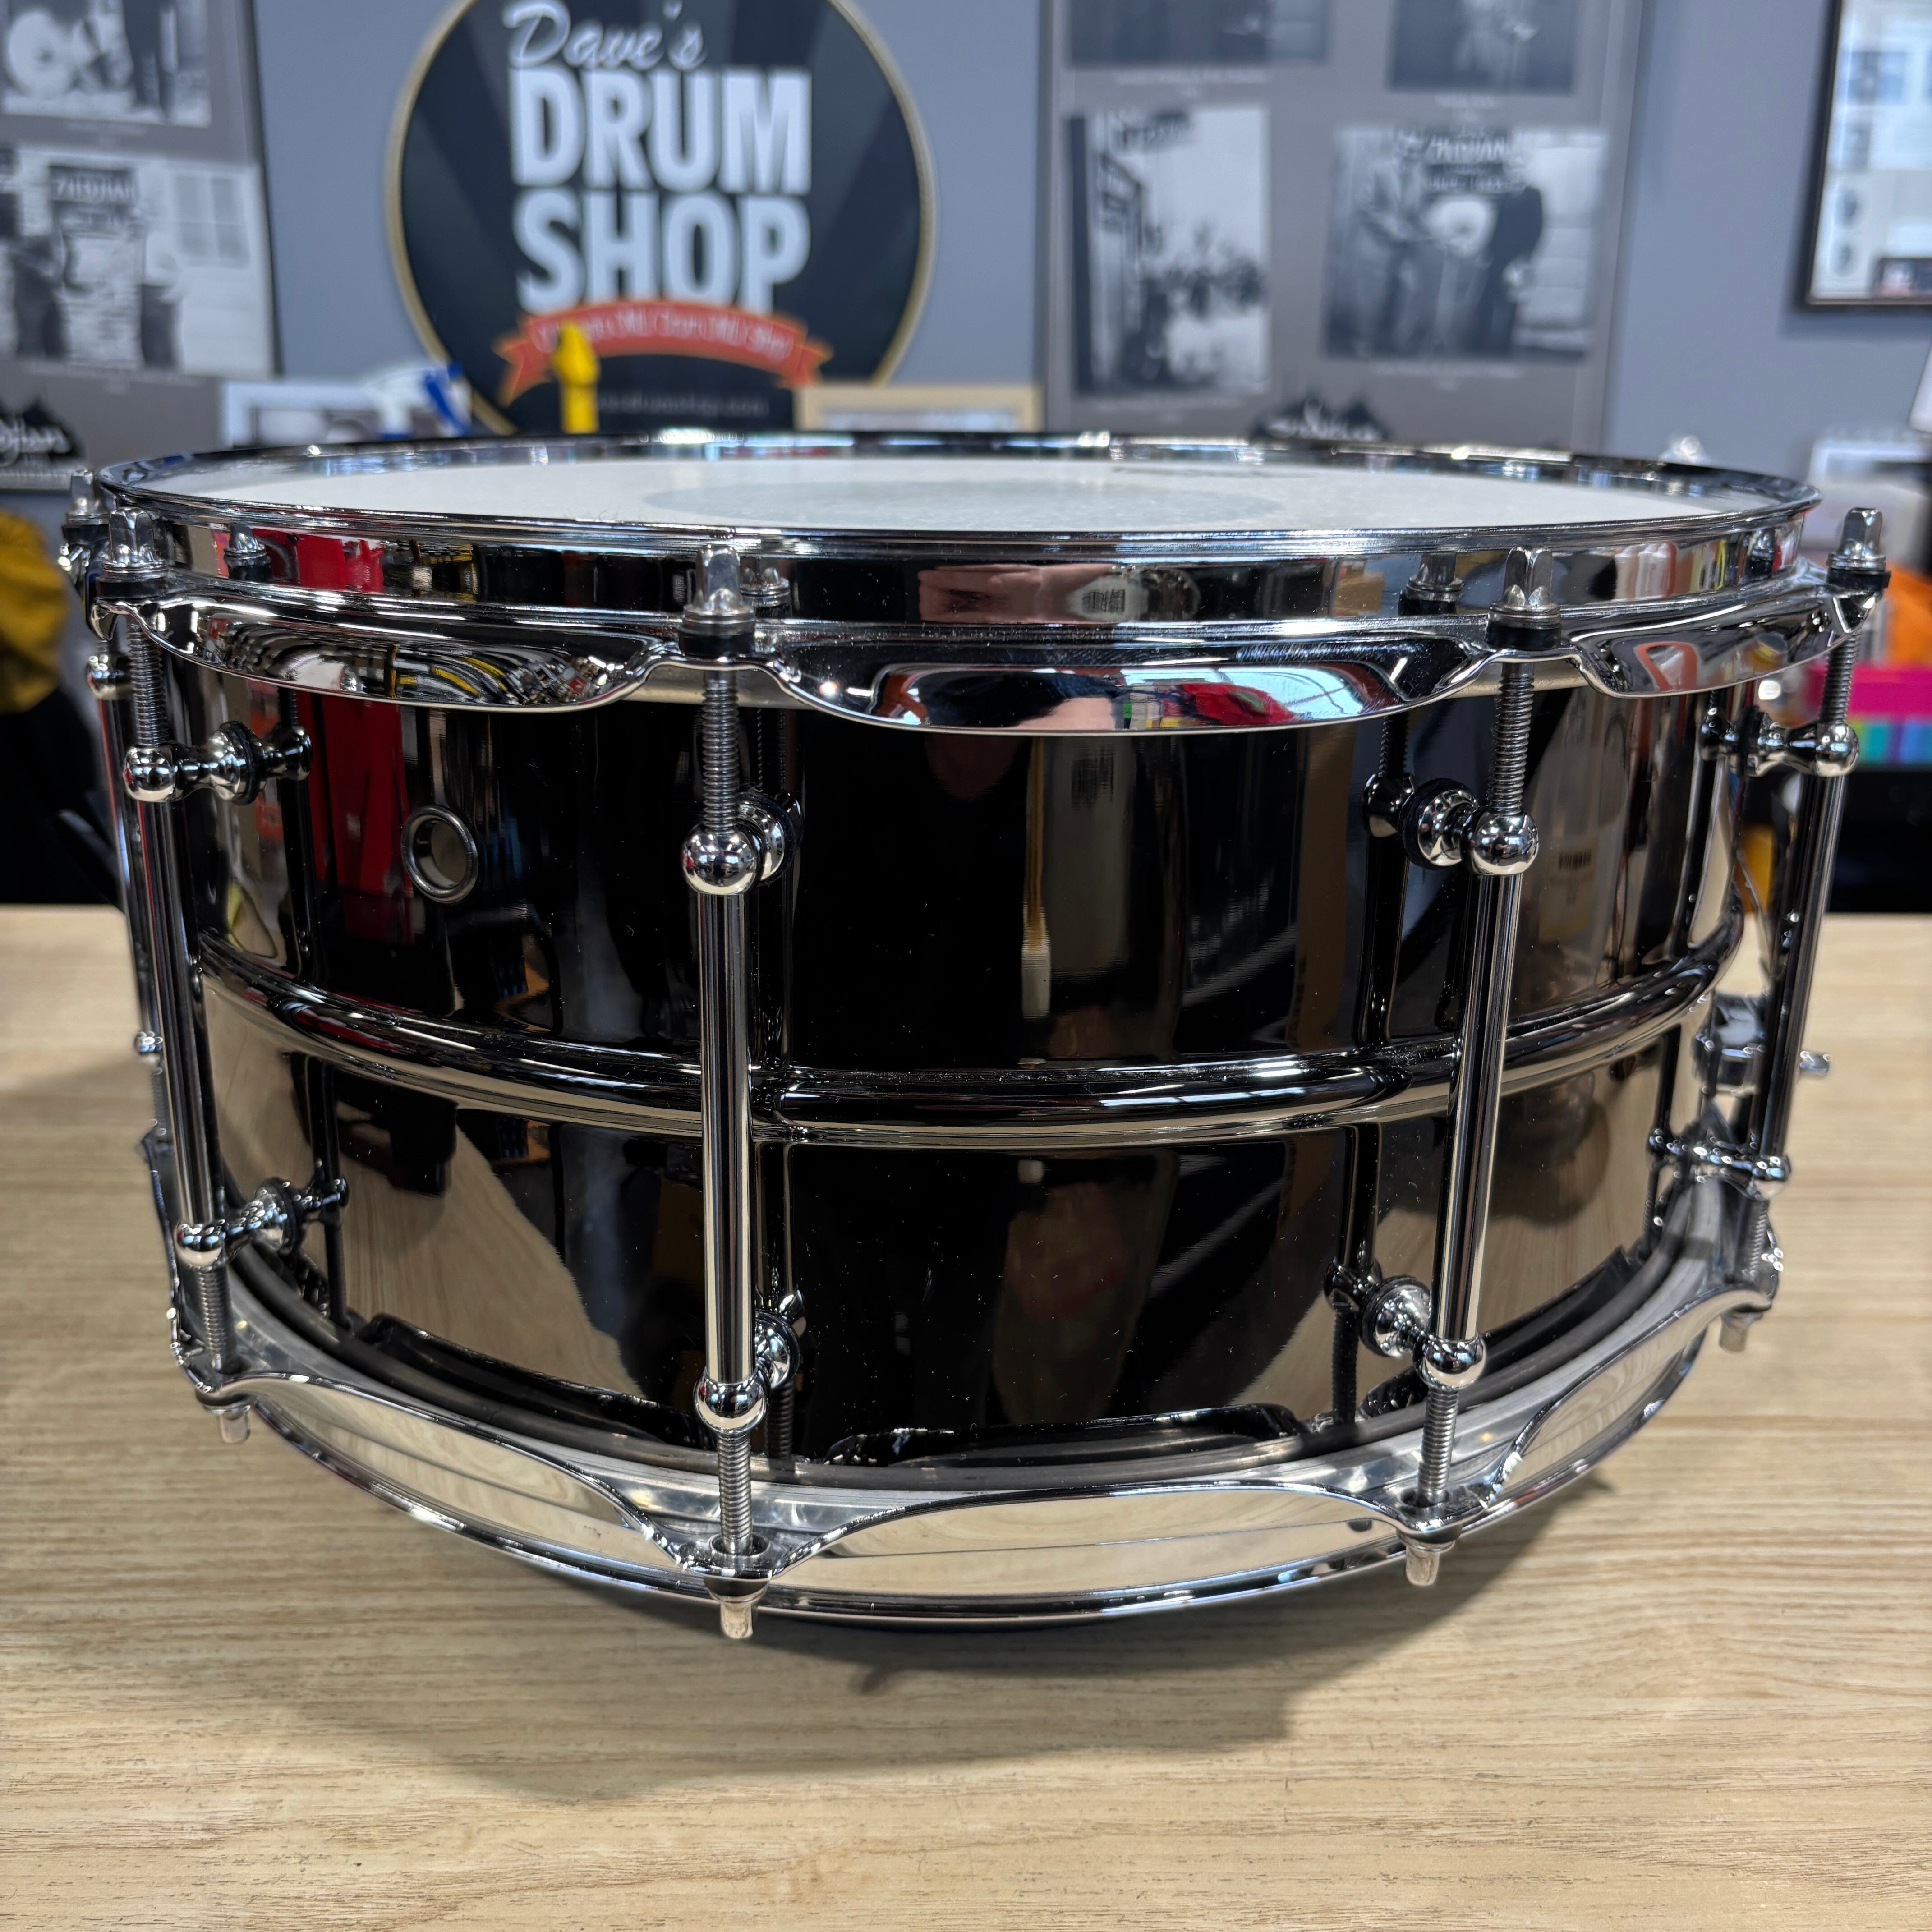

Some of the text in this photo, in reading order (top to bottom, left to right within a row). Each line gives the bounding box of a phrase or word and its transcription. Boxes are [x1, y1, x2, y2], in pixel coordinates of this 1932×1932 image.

[501, 0, 709, 69] Dave's
[509, 63, 813, 194] DRUM
[513, 186, 813, 315] SHOP
